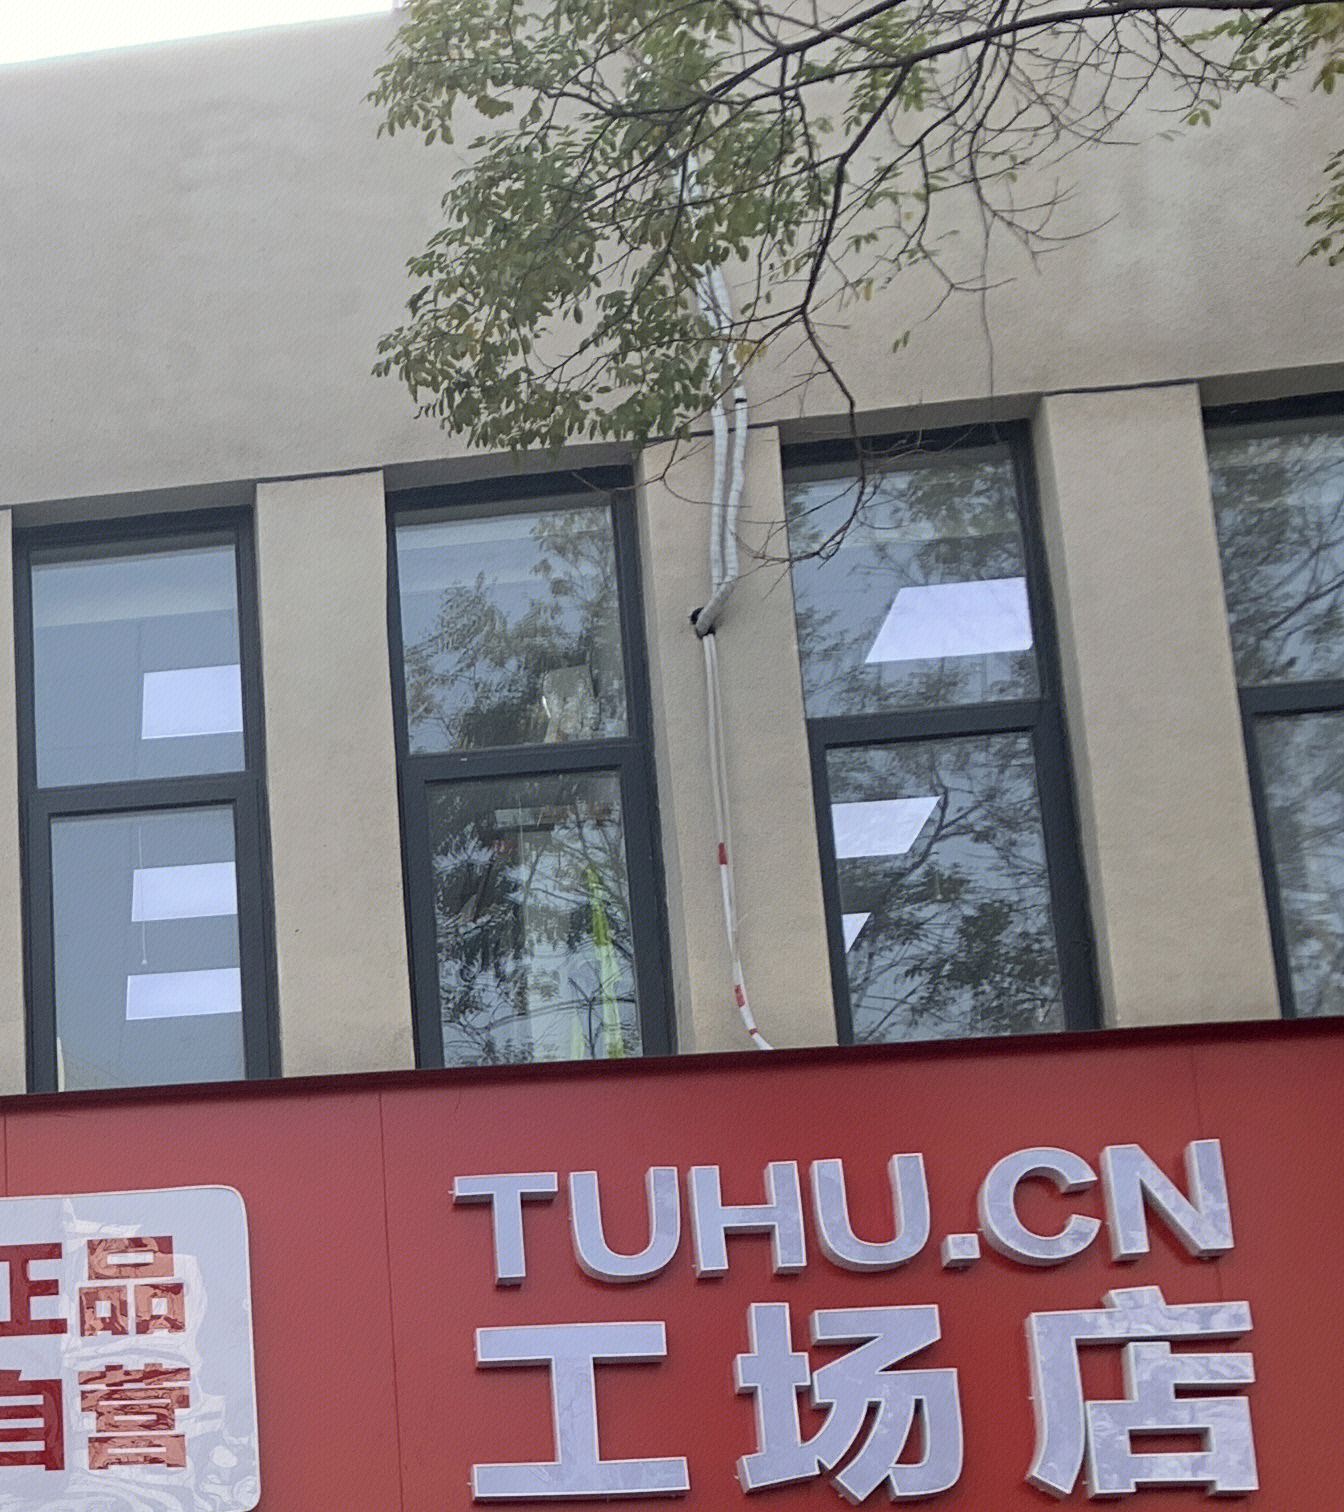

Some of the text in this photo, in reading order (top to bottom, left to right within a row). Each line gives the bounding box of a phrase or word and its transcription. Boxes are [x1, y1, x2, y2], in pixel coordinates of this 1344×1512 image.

[451, 1138, 1234, 1286] TUHU.CN
[469, 1285, 1259, 1505] 工场店
